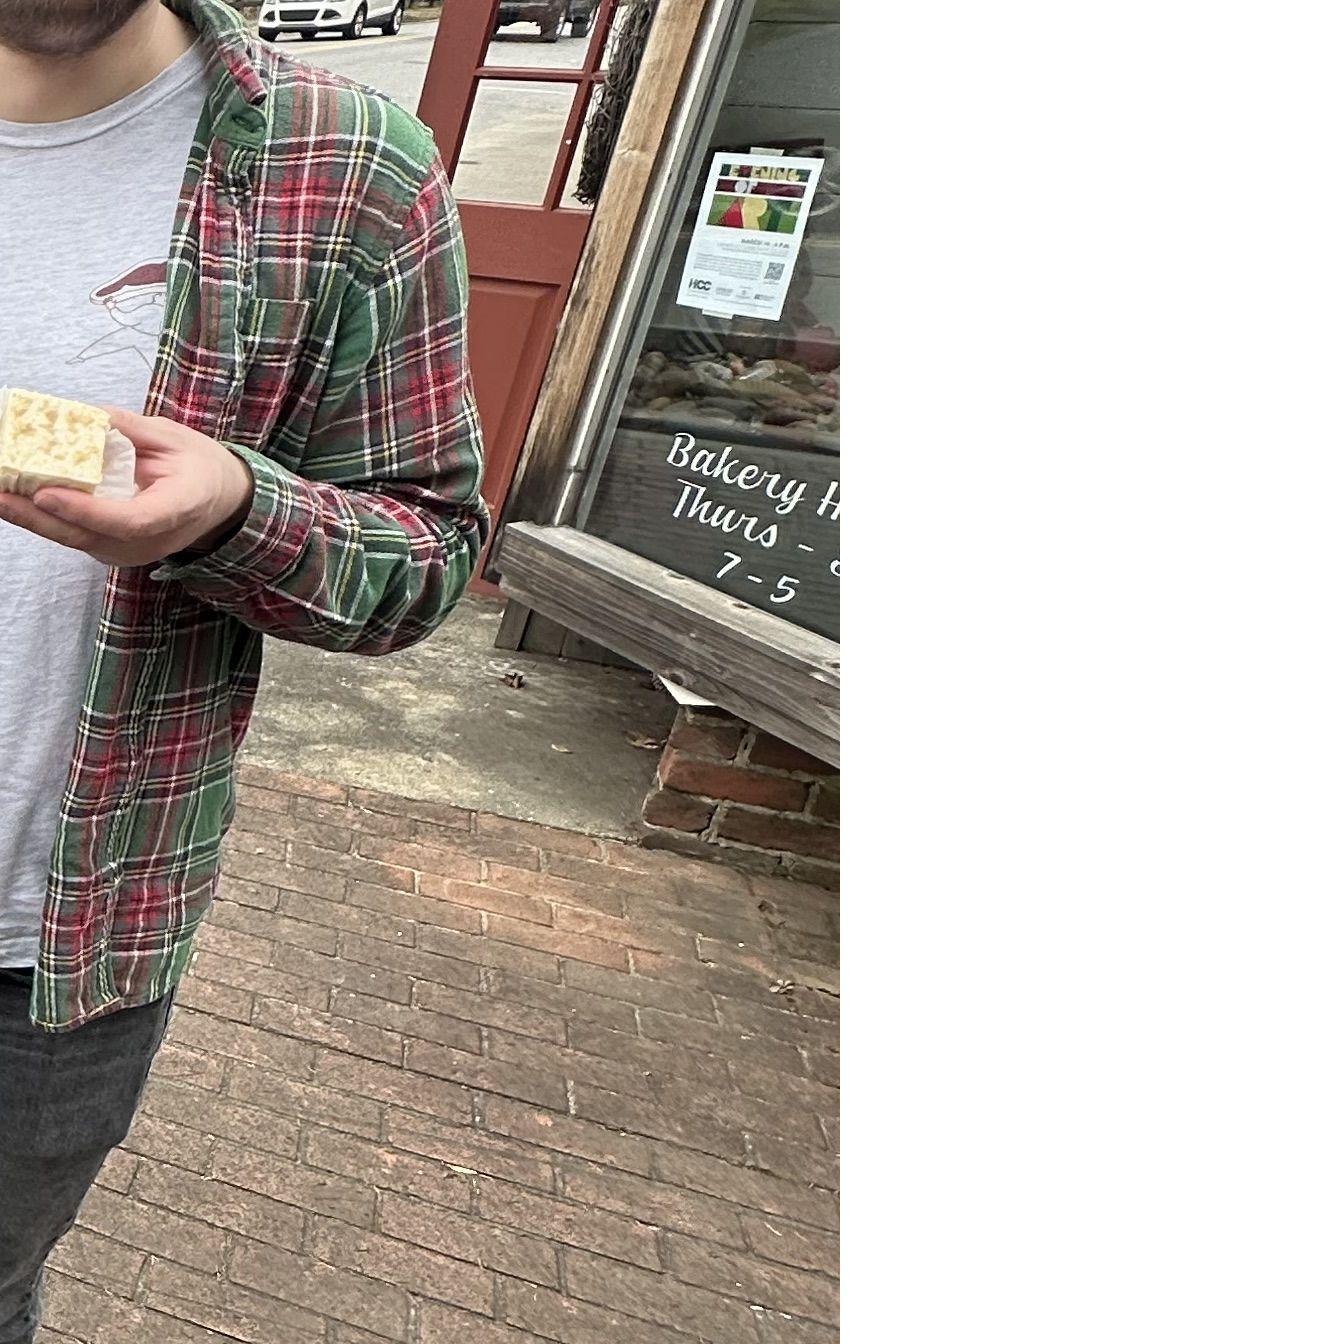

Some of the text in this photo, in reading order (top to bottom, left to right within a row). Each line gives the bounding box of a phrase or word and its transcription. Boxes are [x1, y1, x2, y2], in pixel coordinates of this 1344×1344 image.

[735, 180, 758, 194] OF
[666, 432, 807, 515] Bakery
[672, 478, 778, 548] Thurs
[716, 551, 742, 579] 7
[770, 575, 800, 604] 5
